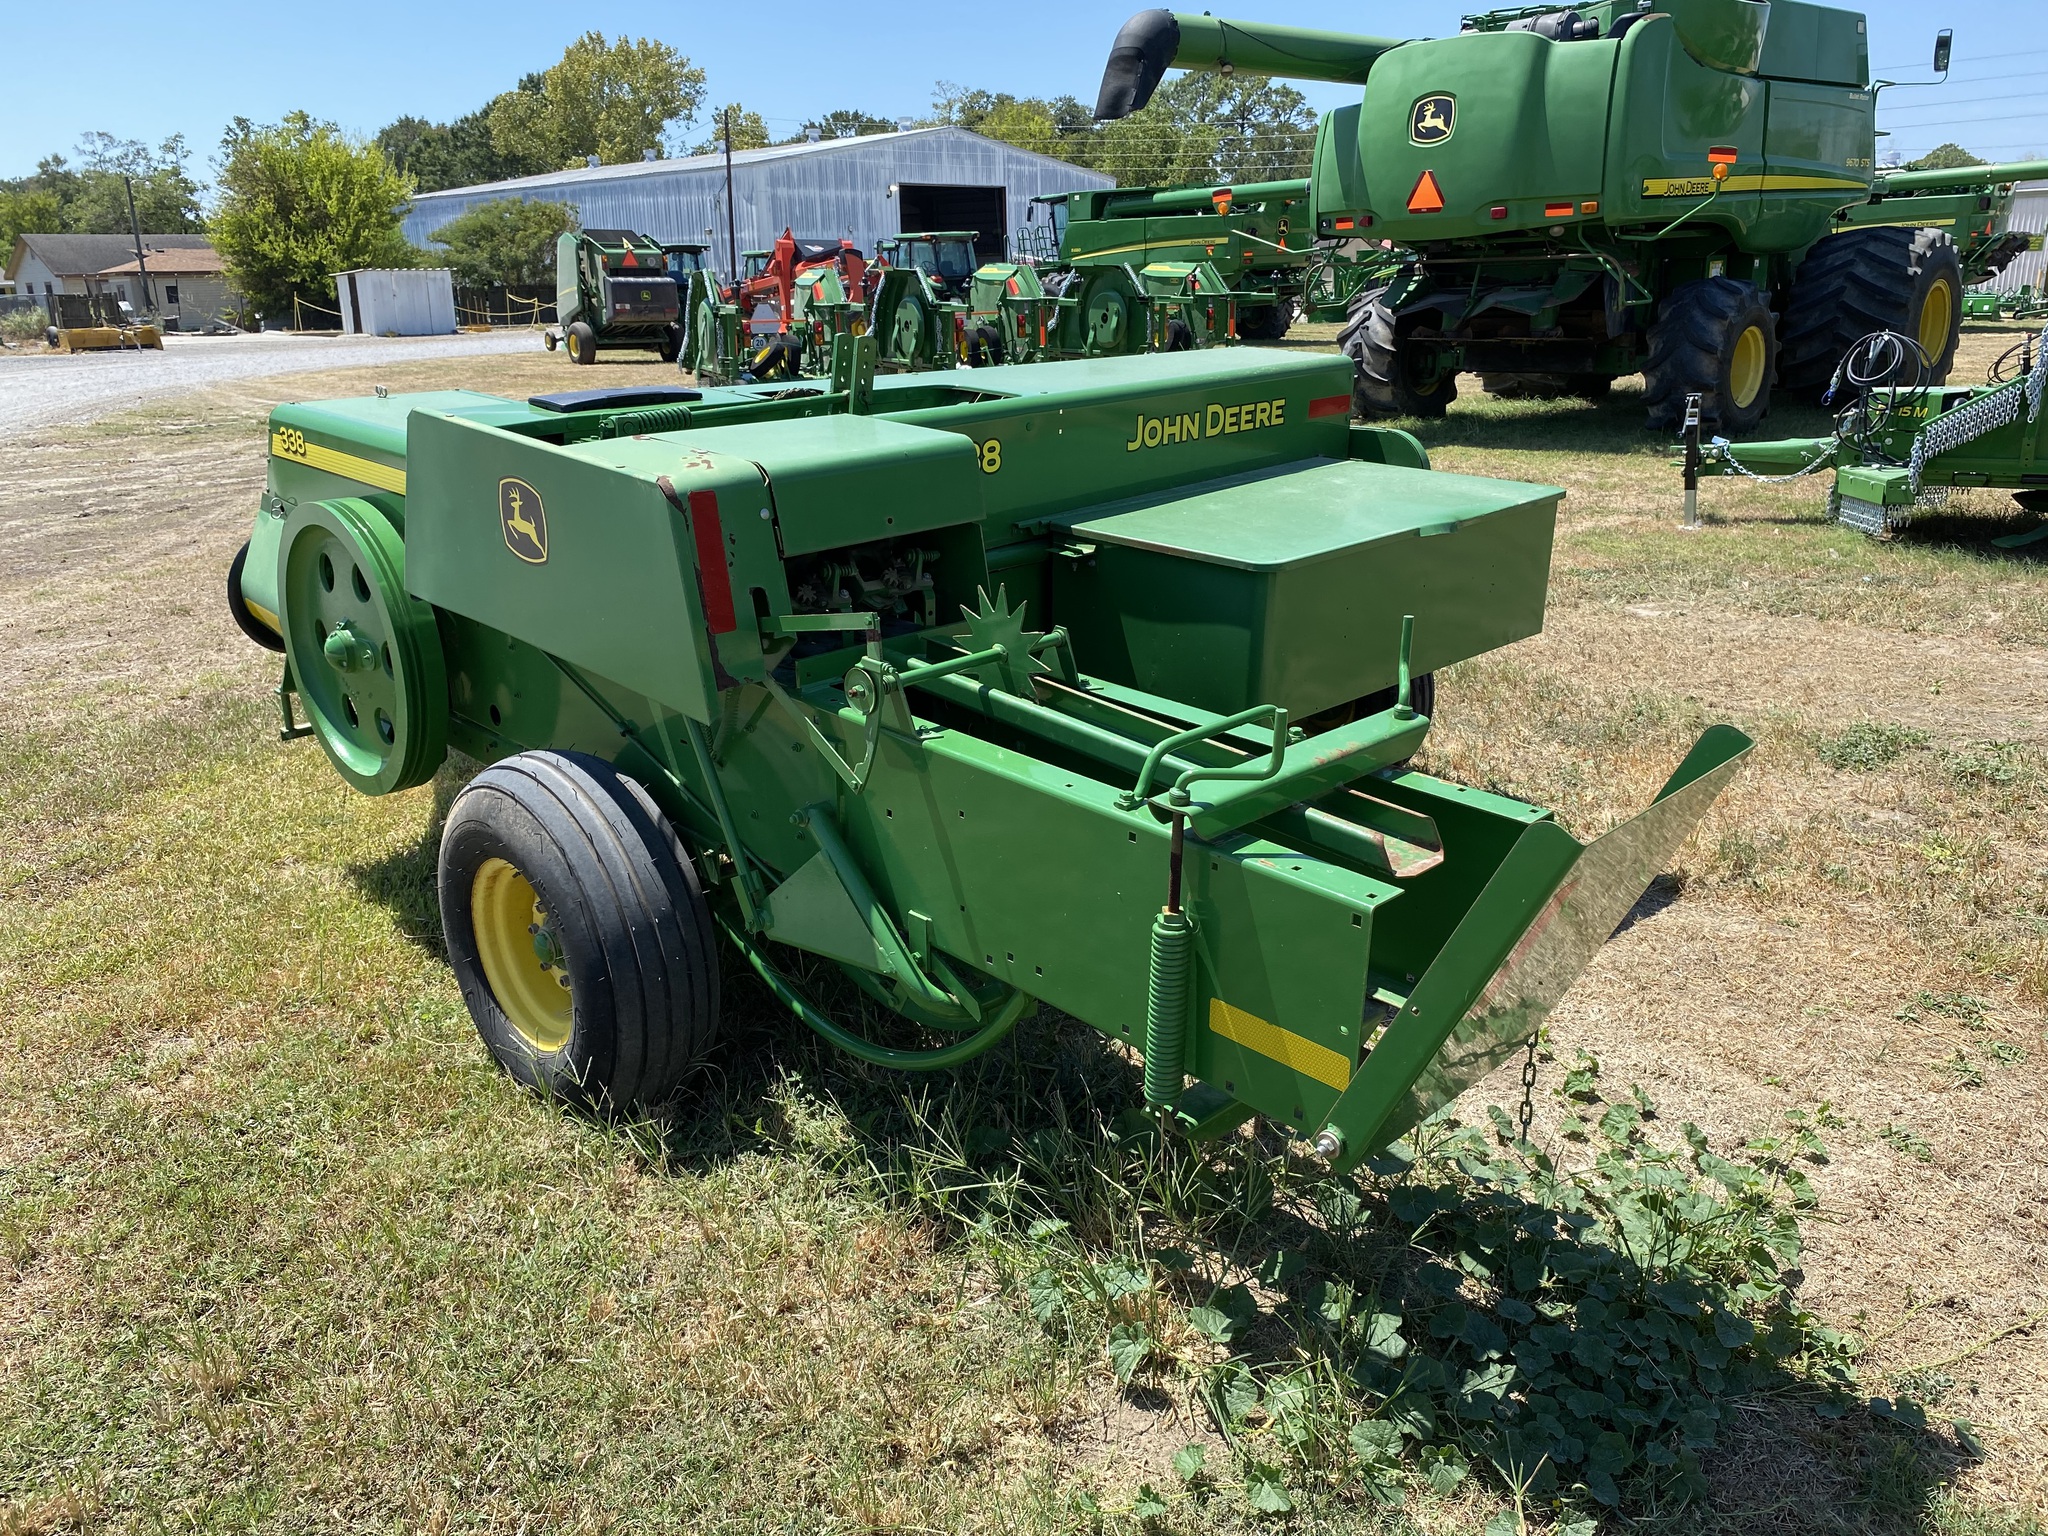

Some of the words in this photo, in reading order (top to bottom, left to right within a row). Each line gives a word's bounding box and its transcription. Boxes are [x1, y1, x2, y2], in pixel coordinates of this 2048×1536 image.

[1860, 158, 1871, 168] STS
[1663, 181, 1686, 196] JOHN
[1686, 180, 1710, 194] DEERE
[1126, 413, 1201, 452] JOHN
[1204, 398, 1286, 438] DEERE
[279, 426, 307, 457] 338
[973, 437, 1002, 475] 8
